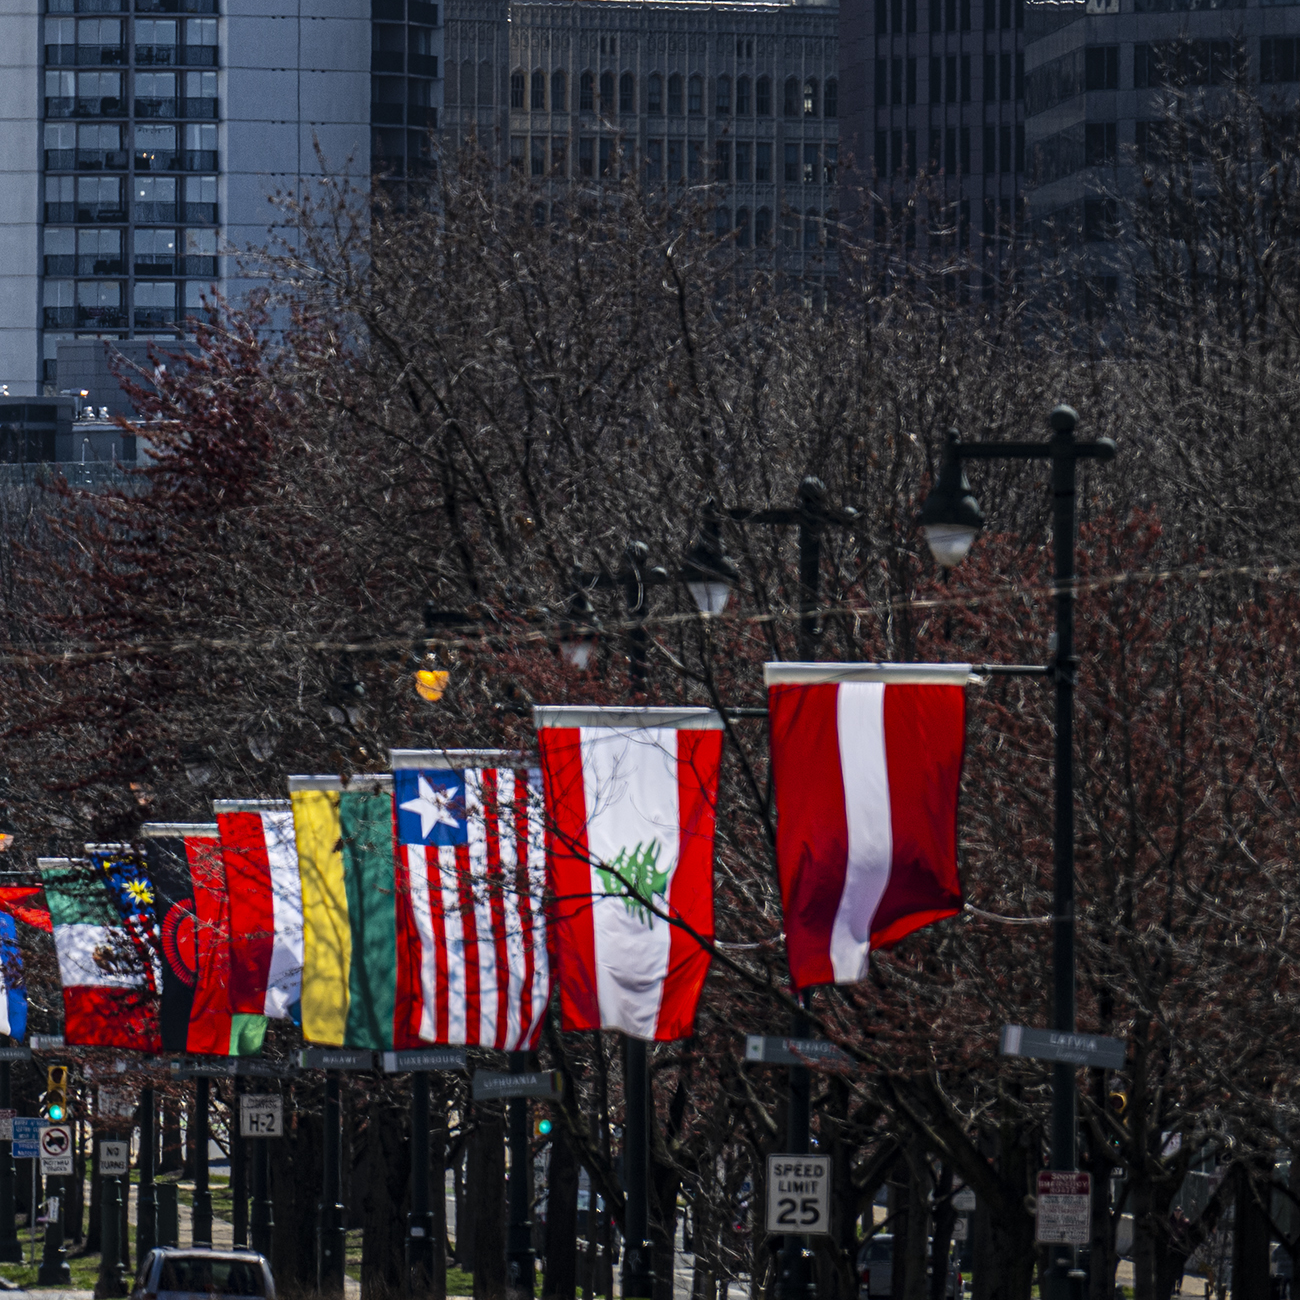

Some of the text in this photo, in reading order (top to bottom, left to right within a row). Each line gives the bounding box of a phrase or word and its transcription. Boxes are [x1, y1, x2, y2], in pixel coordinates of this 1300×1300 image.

[1049, 1033, 1098, 1052] LATVIA
[483, 1074, 538, 1088] LITHUANIA
[248, 1112, 276, 1133] H-2
[106, 1146, 120, 1157] NO
[773, 1163, 825, 1178] SPEED
[777, 1180, 819, 1194] LIMIT
[776, 1197, 821, 1225] 25
